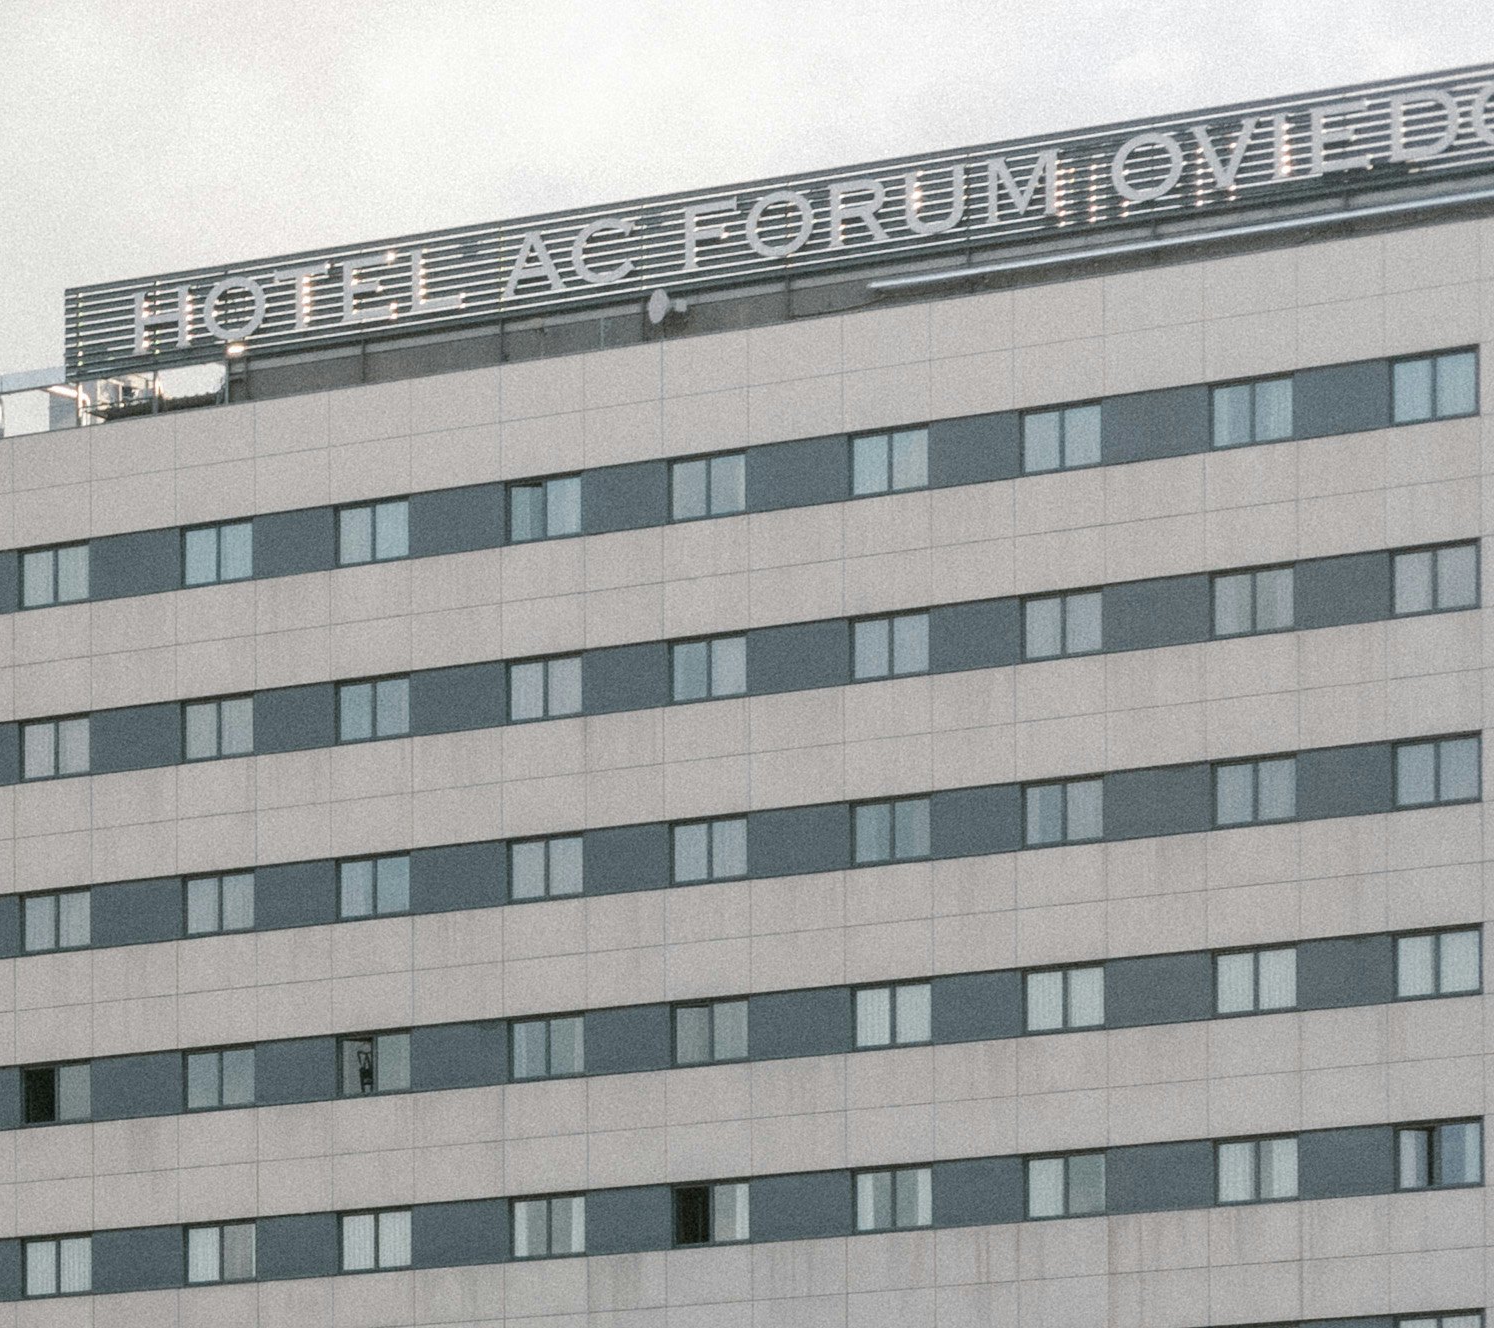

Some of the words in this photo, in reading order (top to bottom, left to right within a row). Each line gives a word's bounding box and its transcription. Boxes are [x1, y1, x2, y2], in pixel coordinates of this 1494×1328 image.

[132, 249, 466, 354] HOTEL
[502, 216, 636, 300] AC
[681, 149, 1060, 270] FORUM
